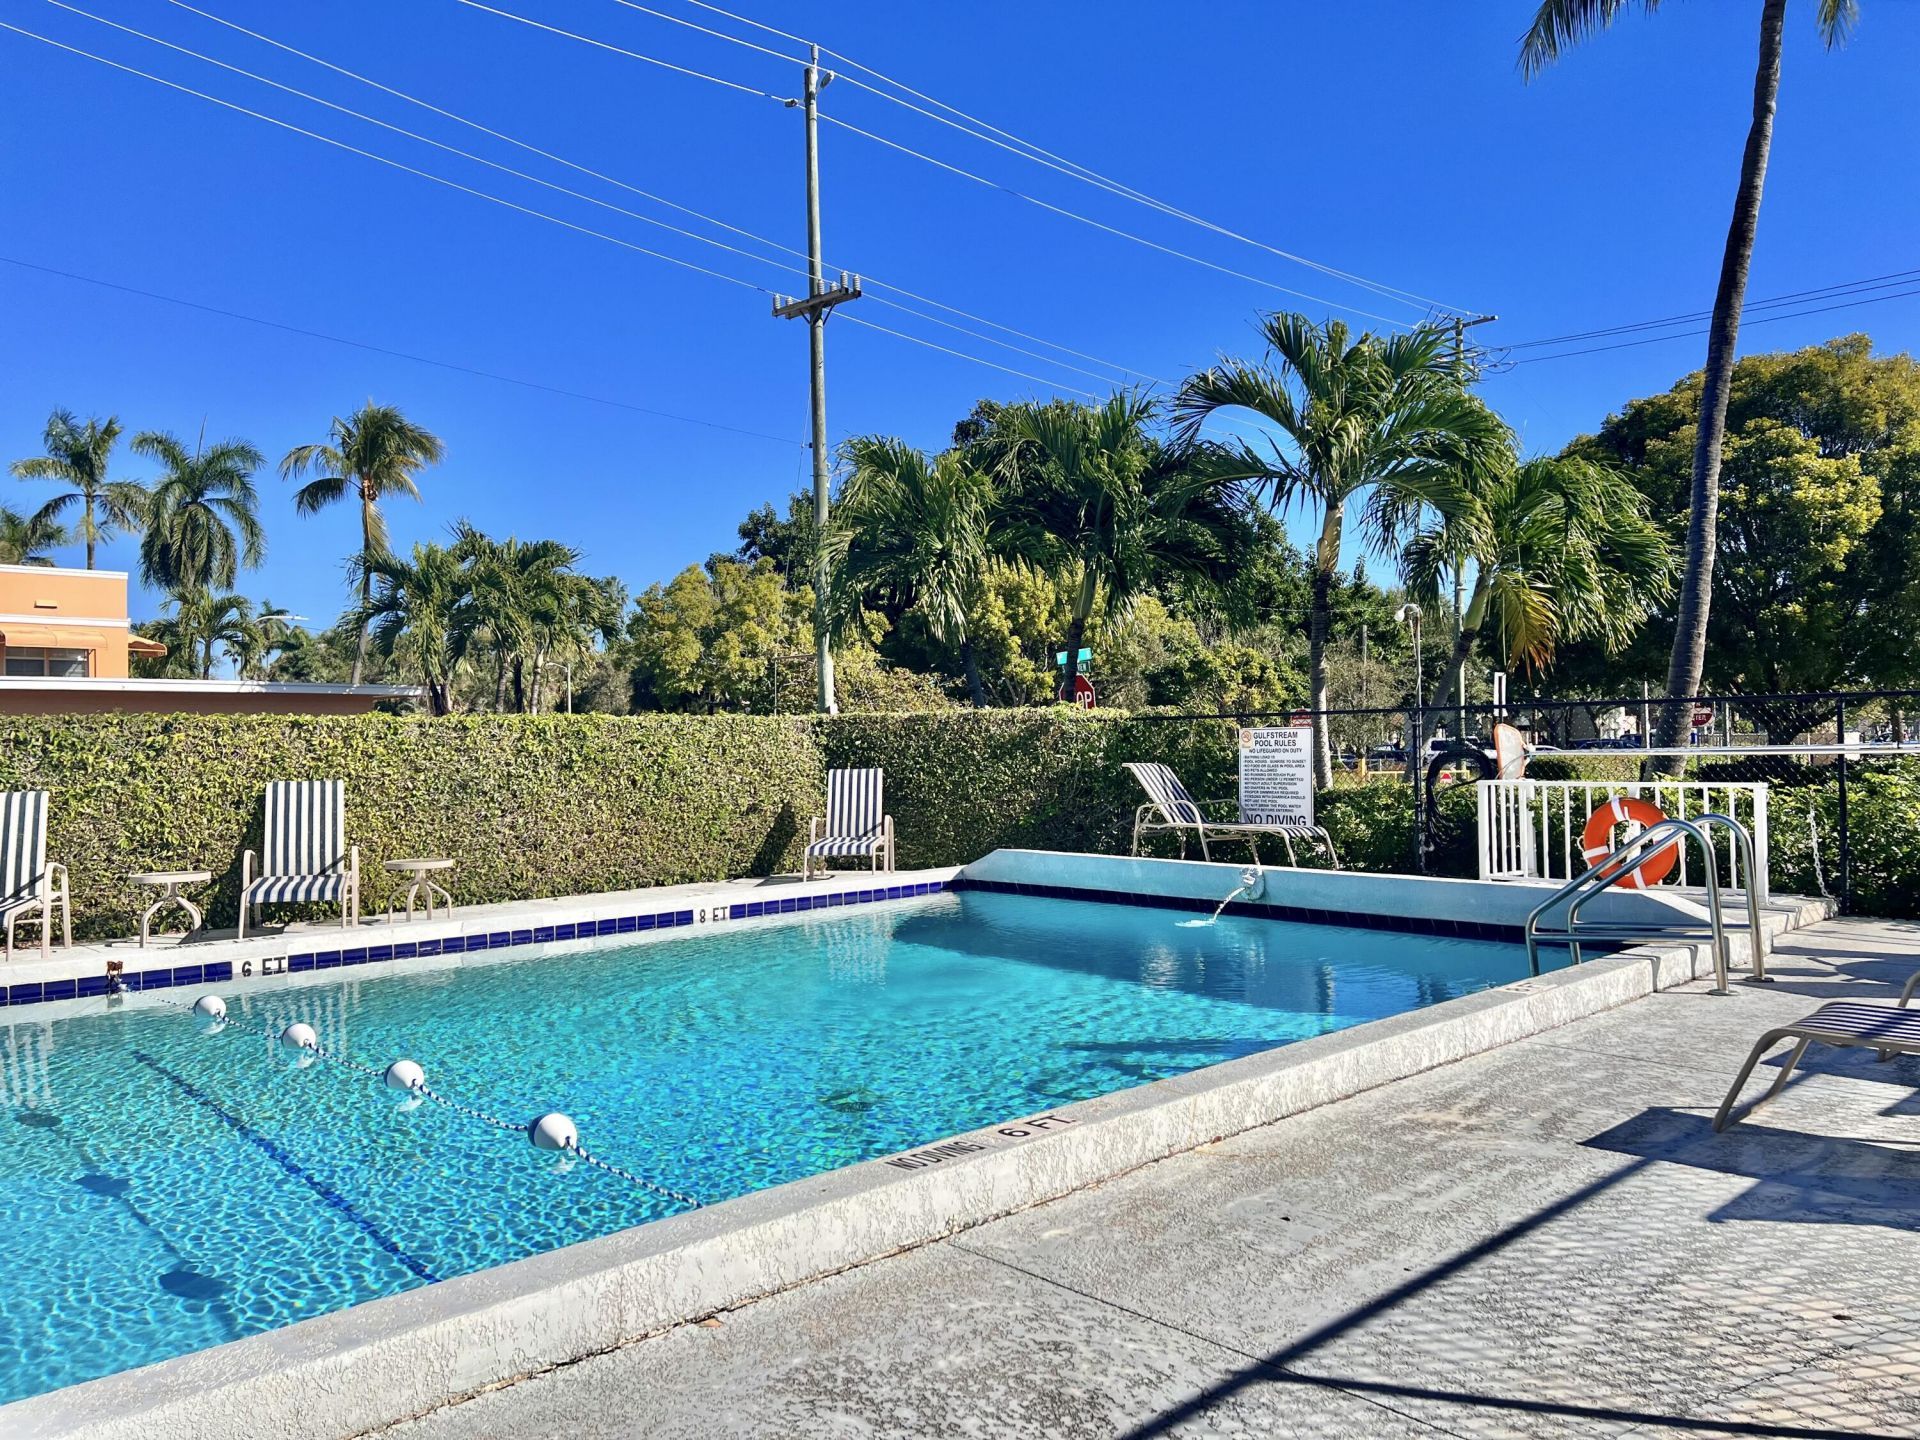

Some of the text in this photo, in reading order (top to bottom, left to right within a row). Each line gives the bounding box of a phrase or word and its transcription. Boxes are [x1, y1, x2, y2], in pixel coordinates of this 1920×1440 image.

[1247, 814, 1306, 826] NO DIVING
[700, 909, 706, 923] 8
[242, 960, 252, 977] 6
[998, 1128, 1030, 1138] 6
[885, 1141, 985, 1171] NO DIVING
